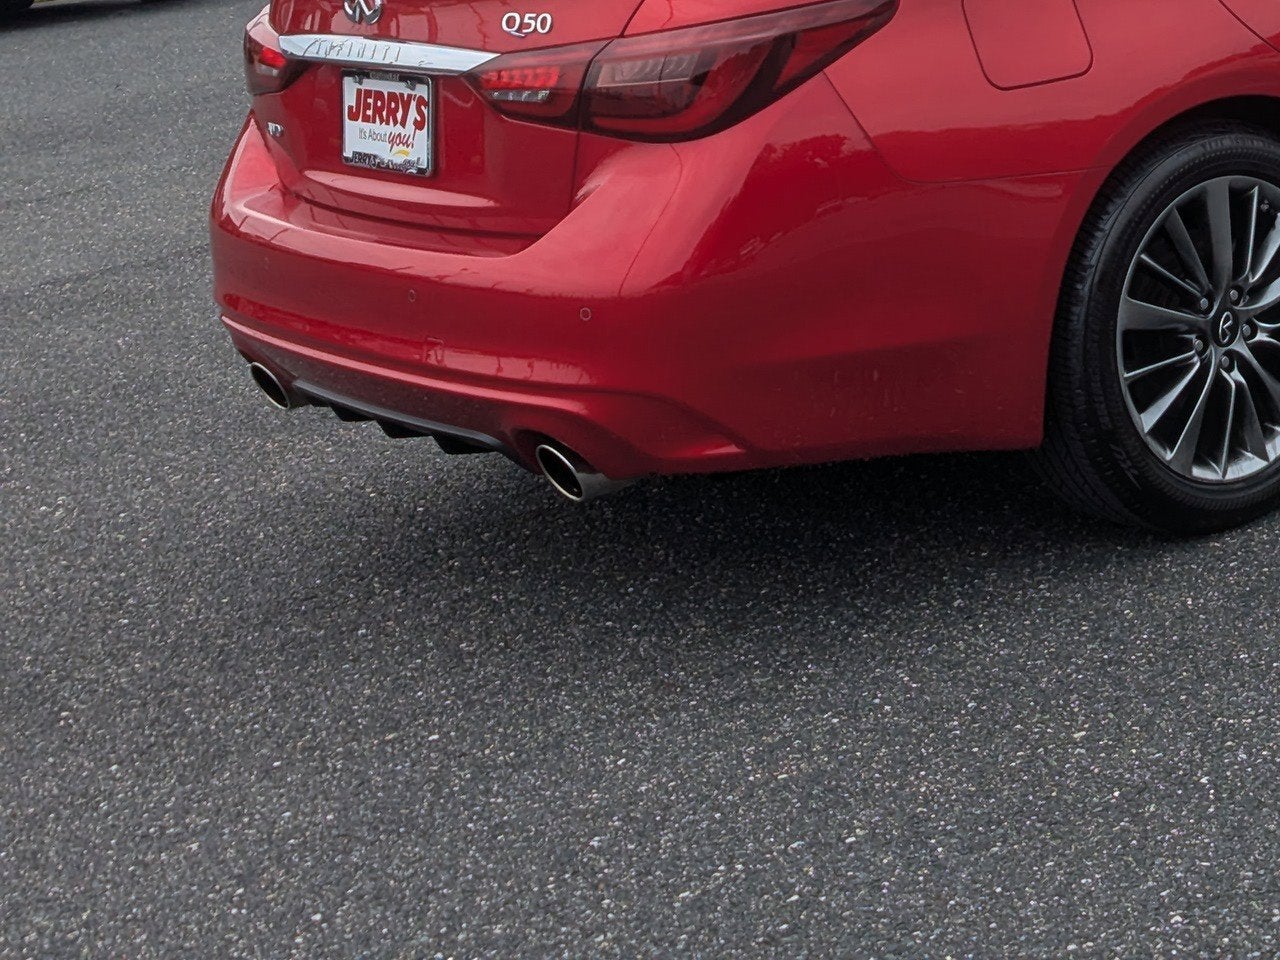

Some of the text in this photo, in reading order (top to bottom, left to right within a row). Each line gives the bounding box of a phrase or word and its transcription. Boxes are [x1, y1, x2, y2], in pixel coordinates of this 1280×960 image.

[501, 11, 552, 38] Q50
[347, 87, 428, 132] JERRY'S
[359, 126, 418, 153] It's About you!
